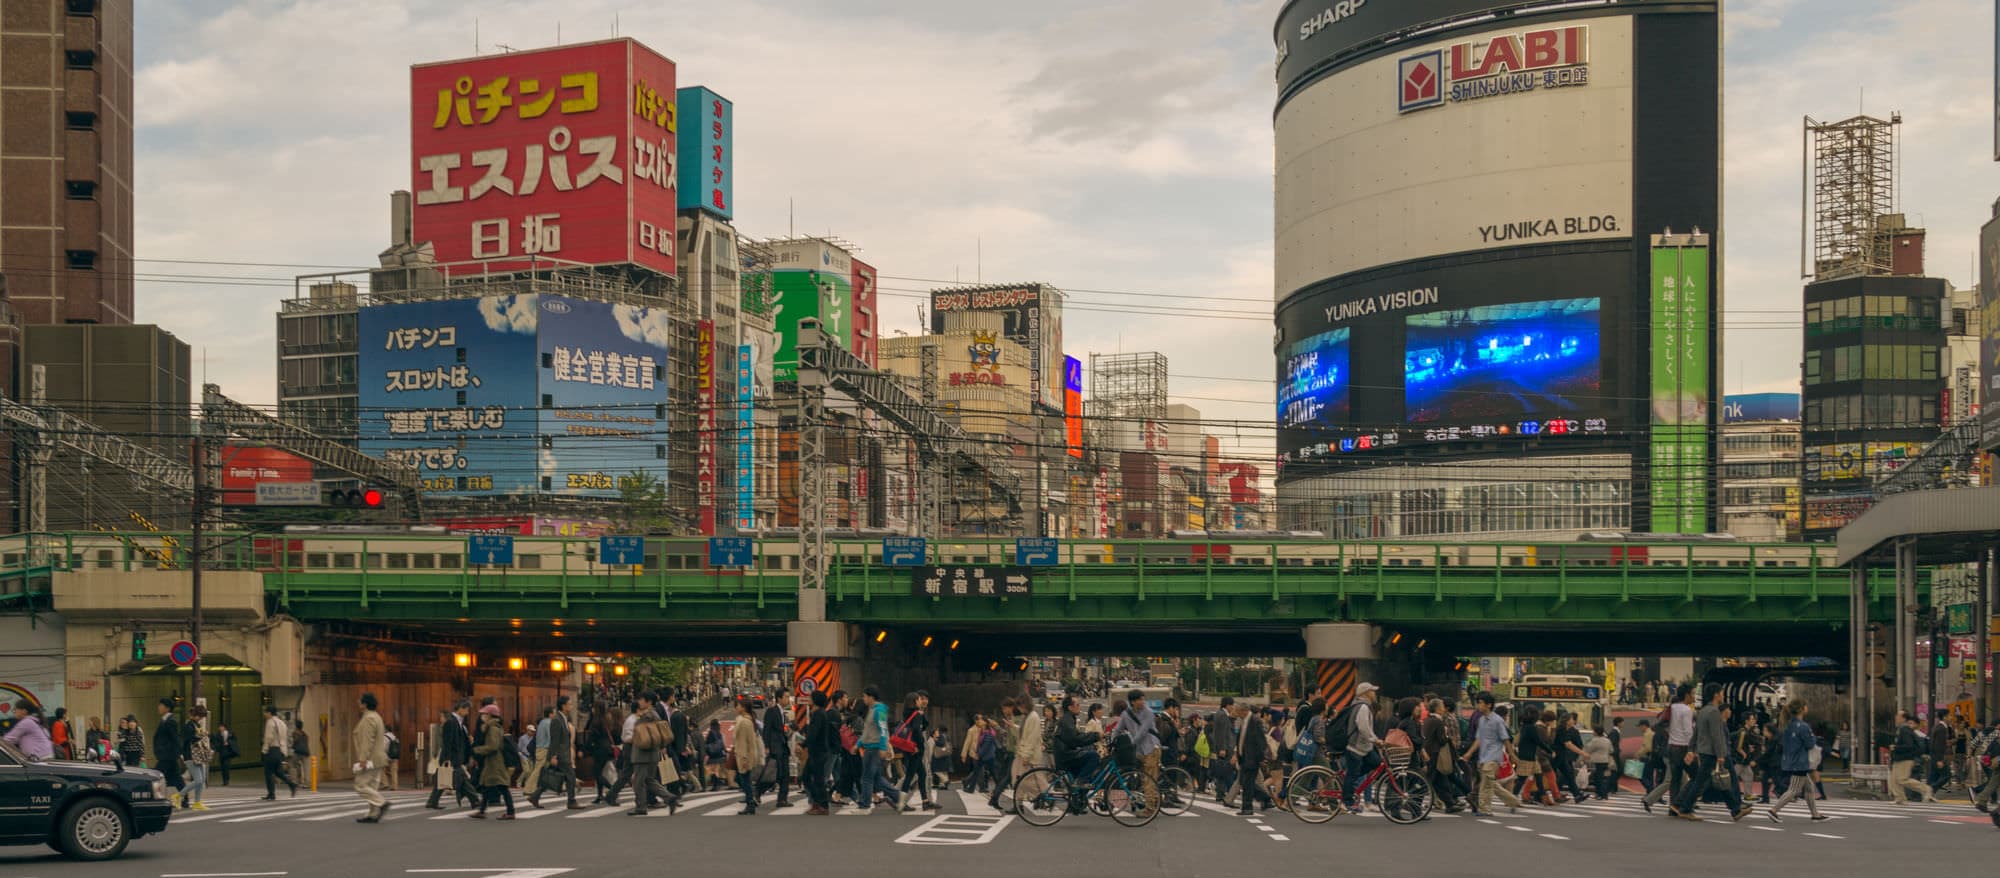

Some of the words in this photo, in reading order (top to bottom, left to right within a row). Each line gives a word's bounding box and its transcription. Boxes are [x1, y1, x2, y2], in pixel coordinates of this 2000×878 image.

[1300, 0, 1365, 40] SHARP
[1450, 25, 1588, 81] LABI
[433, 72, 599, 128] パチンコ
[635, 78, 676, 133] パチンコ
[1450, 72, 1535, 101] SHINJUKU
[1543, 67, 1588, 88] 東口館
[417, 126, 624, 205] エスパス
[635, 136, 677, 192] エスパス
[712, 99, 726, 210] カラオケ館
[1479, 219, 1558, 243] YUNIKA
[1564, 214, 1621, 235] BLDG.
[829, 281, 842, 345] レイ
[935, 294, 969, 311] エンタメ
[972, 289, 1038, 309] レストランタワー
[1325, 297, 1377, 323] YUNIKA
[1379, 286, 1439, 312] VISION
[385, 326, 457, 351] パチンコ
[699, 328, 711, 389] パチンコ
[386, 366, 482, 393] スロットは、
[552, 345, 657, 391] 健全営業宣言
[699, 393, 712, 477] エスパス
[560, 522, 581, 536] 4F
[925, 577, 995, 595] 新宿駅
[30, 796, 51, 804] TAXI
